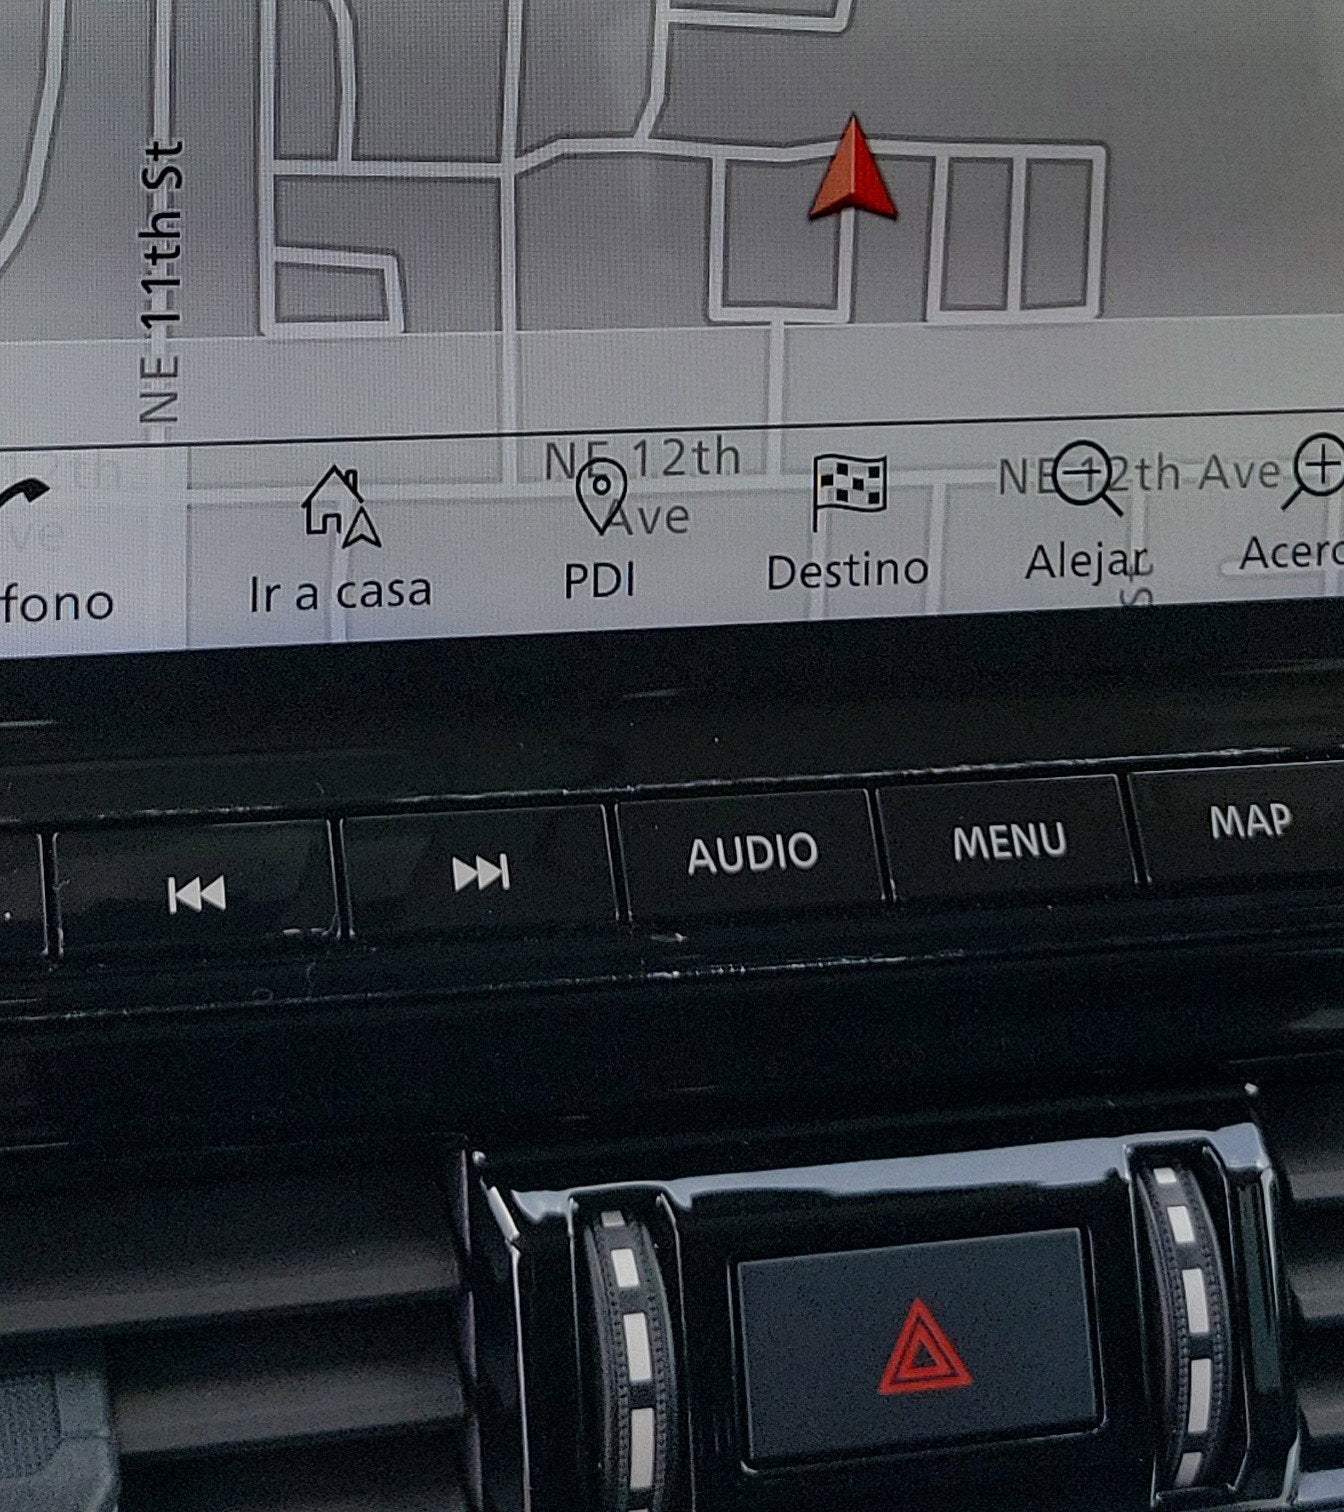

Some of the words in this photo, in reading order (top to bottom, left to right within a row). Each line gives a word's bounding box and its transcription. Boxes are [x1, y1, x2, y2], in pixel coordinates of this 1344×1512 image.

[141, 140, 184, 189] St
[138, 210, 182, 330] 11th
[138, 355, 179, 425] NE
[545, 440, 609, 481] NE
[633, 433, 741, 478] 12th
[999, 457, 1059, 495] NE
[1197, 453, 1282, 491] Ave
[606, 498, 690, 536] Ave
[565, 560, 634, 599] PDI
[768, 551, 930, 591] Destino
[1025, 540, 1149, 587] Alejar
[250, 575, 281, 613] Ir
[295, 582, 320, 612] a
[336, 576, 433, 610] casa
[954, 820, 1068, 862] MENU
[1209, 801, 1293, 840] MAP
[687, 831, 819, 877] AUDIO
